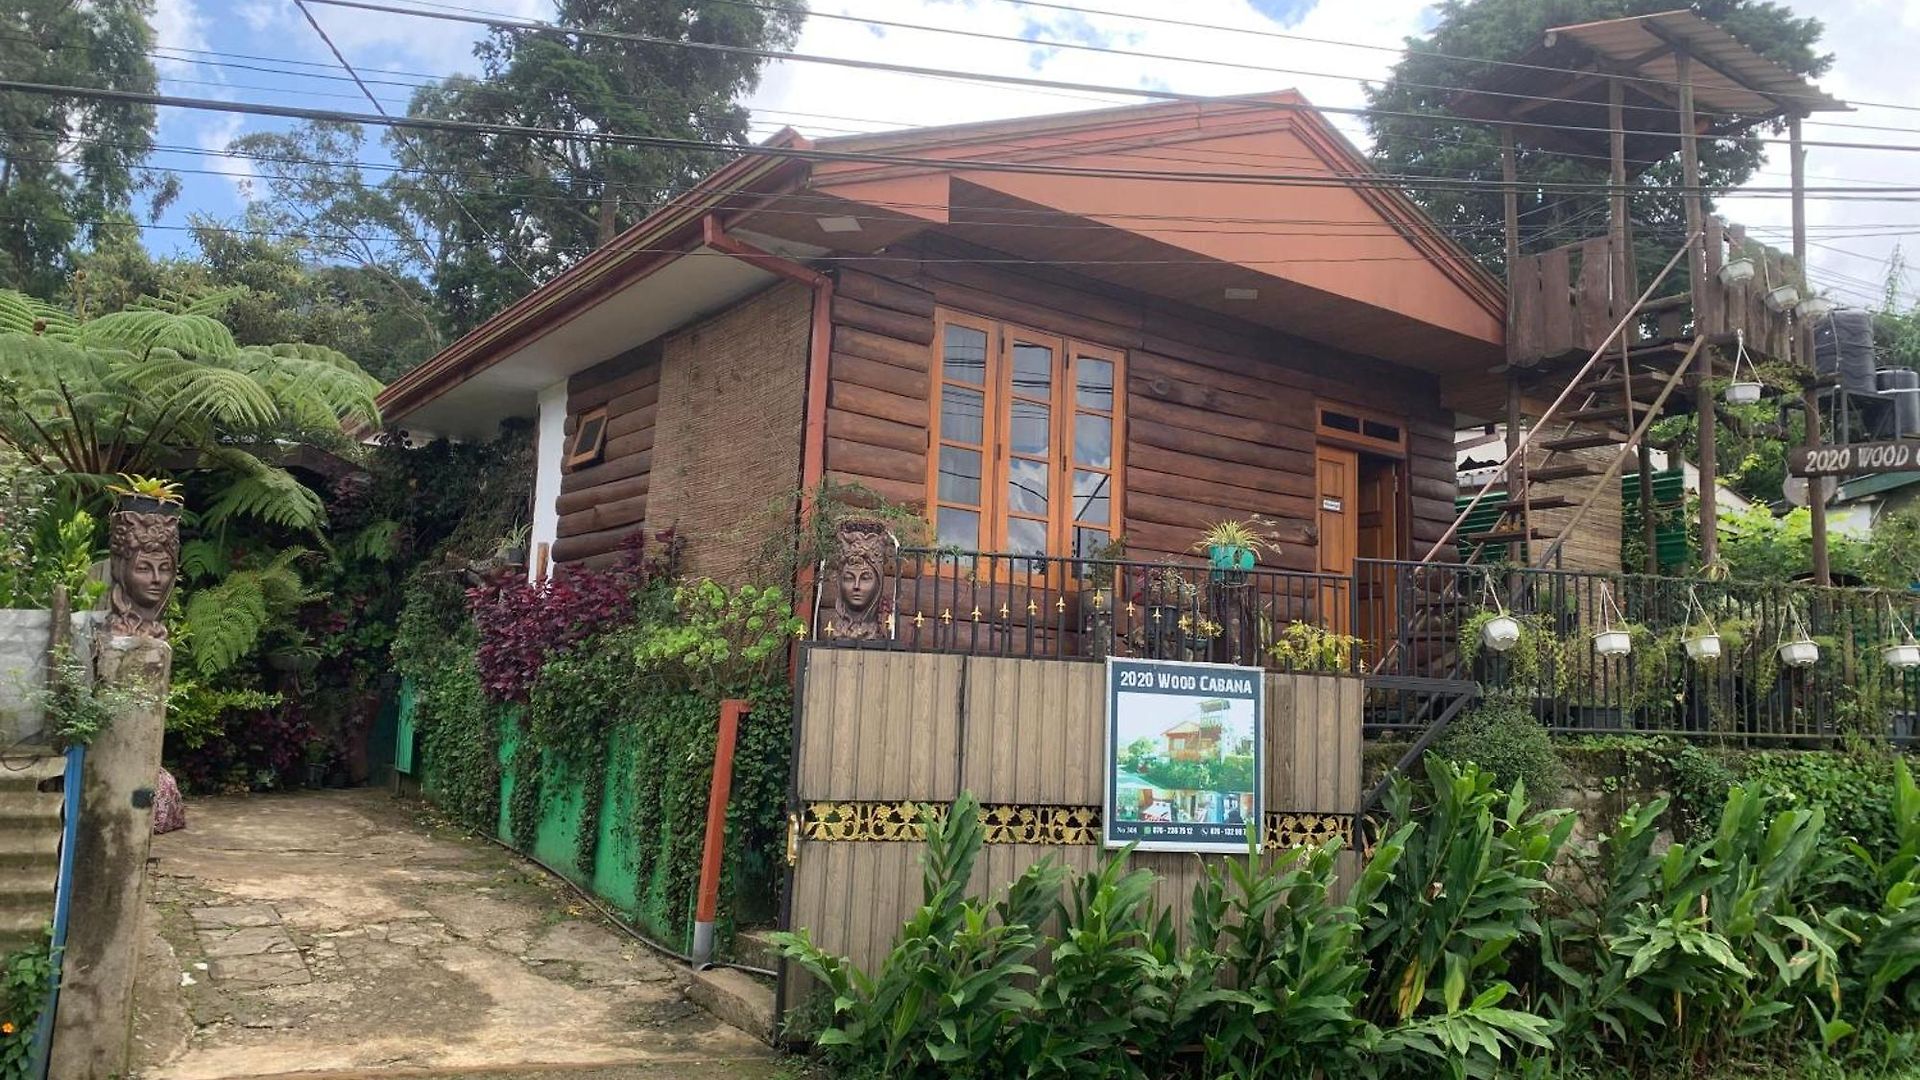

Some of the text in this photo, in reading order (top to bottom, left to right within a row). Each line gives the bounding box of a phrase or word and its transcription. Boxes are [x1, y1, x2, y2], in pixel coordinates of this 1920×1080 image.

[1805, 449, 1851, 472] 2020
[1858, 444, 1909, 468] WOOD
[1121, 671, 1153, 687] 2020
[1200, 676, 1252, 694] CABANA
